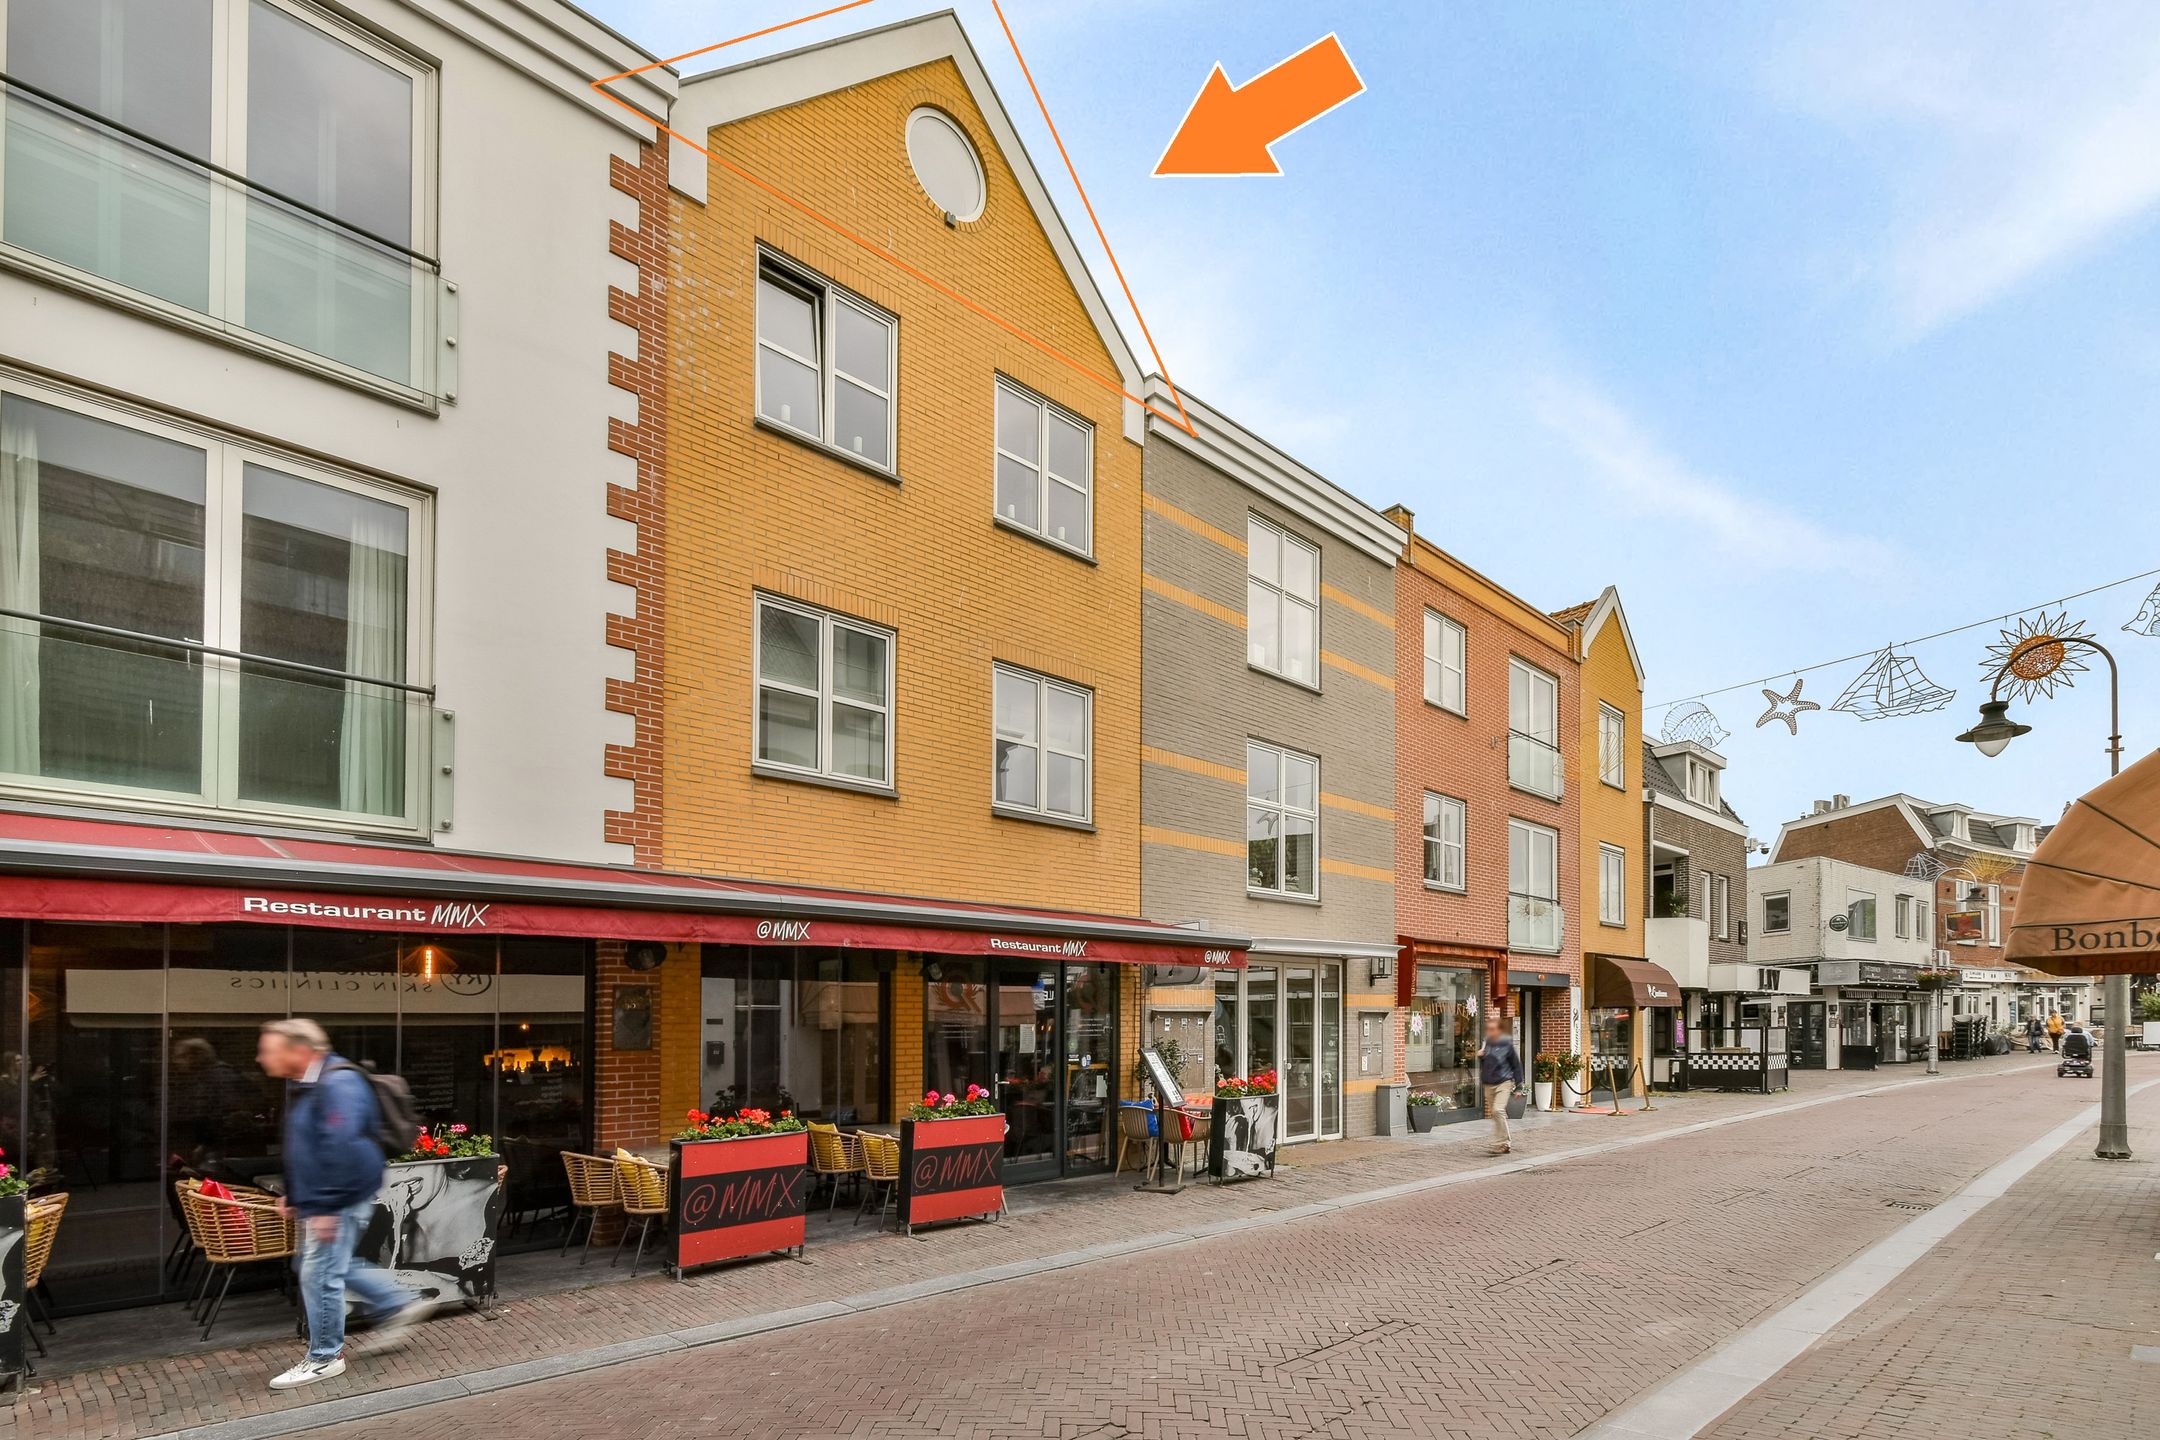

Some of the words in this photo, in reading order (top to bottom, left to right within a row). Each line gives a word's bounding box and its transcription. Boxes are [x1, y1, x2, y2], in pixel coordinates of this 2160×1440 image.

[243, 897, 425, 922] Restaurant
[430, 902, 490, 929] MMX
[756, 920, 810, 941] @MMX
[2051, 921, 2160, 951] Bonb
[990, 938, 1062, 955] Restaurant
[1062, 940, 1087, 957] MMX
[1203, 950, 1231, 965] @MMX
[913, 1143, 1003, 1189] @MMX
[683, 1167, 806, 1227] @MMX
